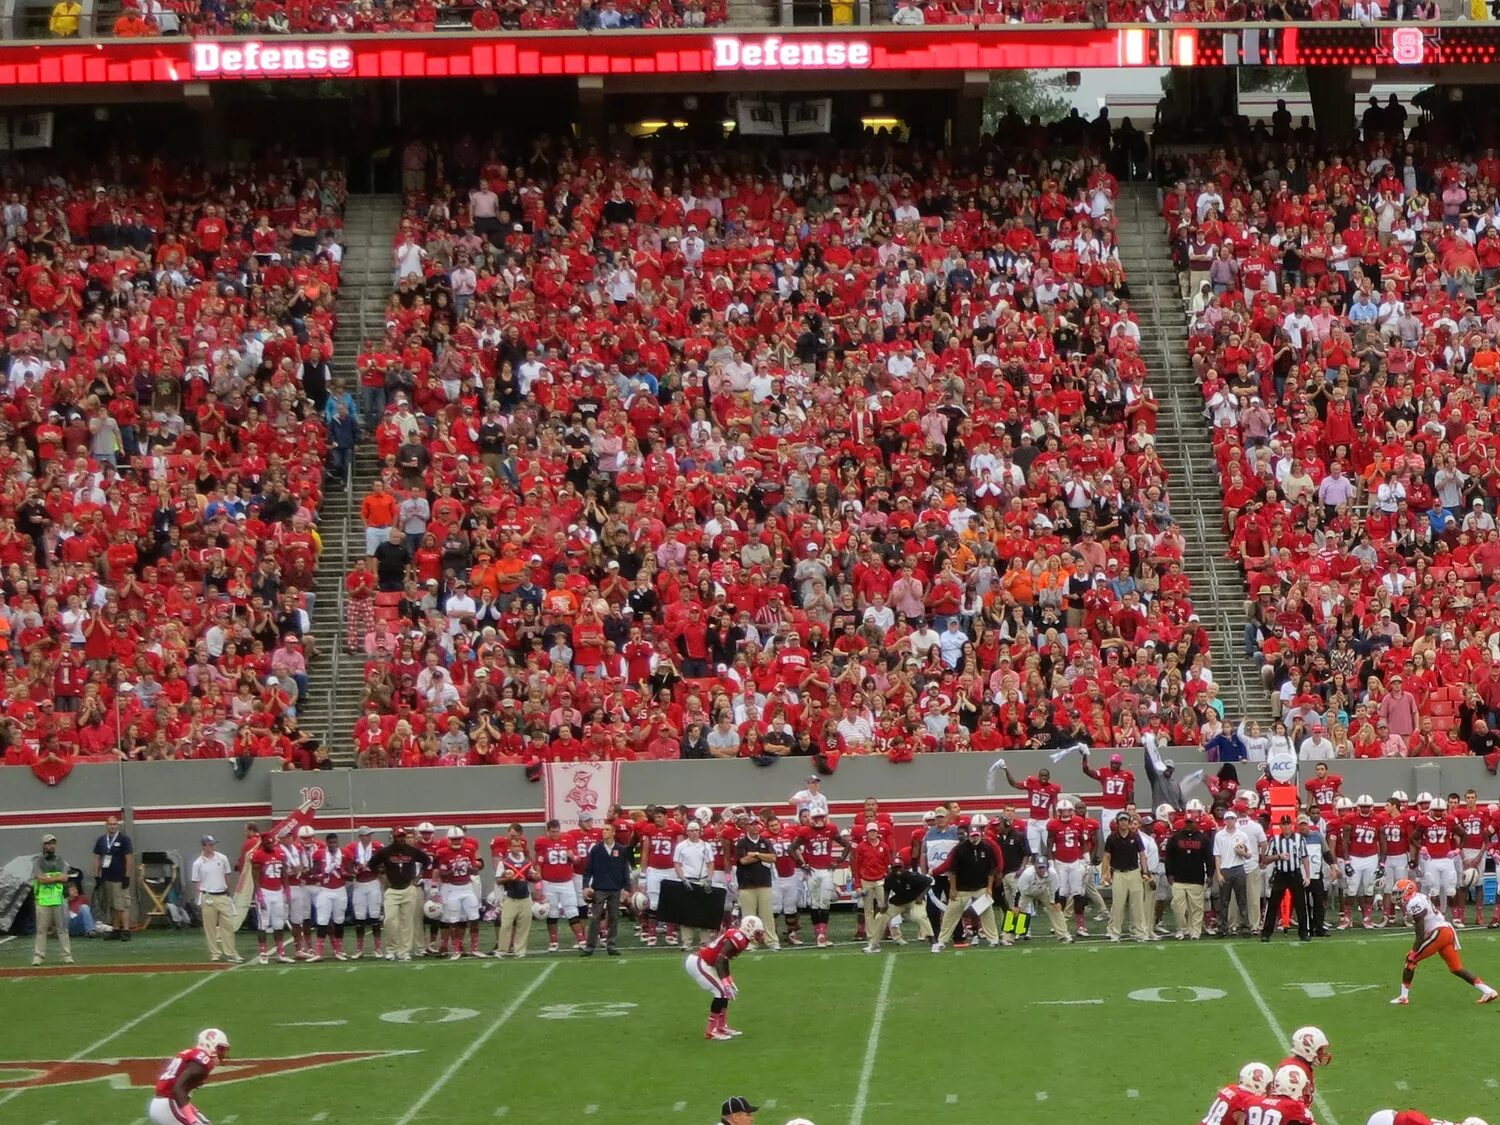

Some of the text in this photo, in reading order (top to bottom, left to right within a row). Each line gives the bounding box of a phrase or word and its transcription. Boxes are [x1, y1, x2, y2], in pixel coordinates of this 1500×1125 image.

[192, 42, 352, 75] Defense
[712, 37, 872, 69] Defense
[1270, 761, 1292, 772] ACC
[1106, 780, 1125, 795] 87
[300, 787, 325, 809] 19
[1032, 794, 1049, 808] 87
[1065, 834, 1074, 847] 5
[1355, 828, 1375, 844] 70
[652, 840, 671, 855] 73
[812, 841, 829, 856] 31
[932, 852, 951, 862] AC
[1410, 904, 1422, 914] 25
[196, 1051, 210, 1065] 20
